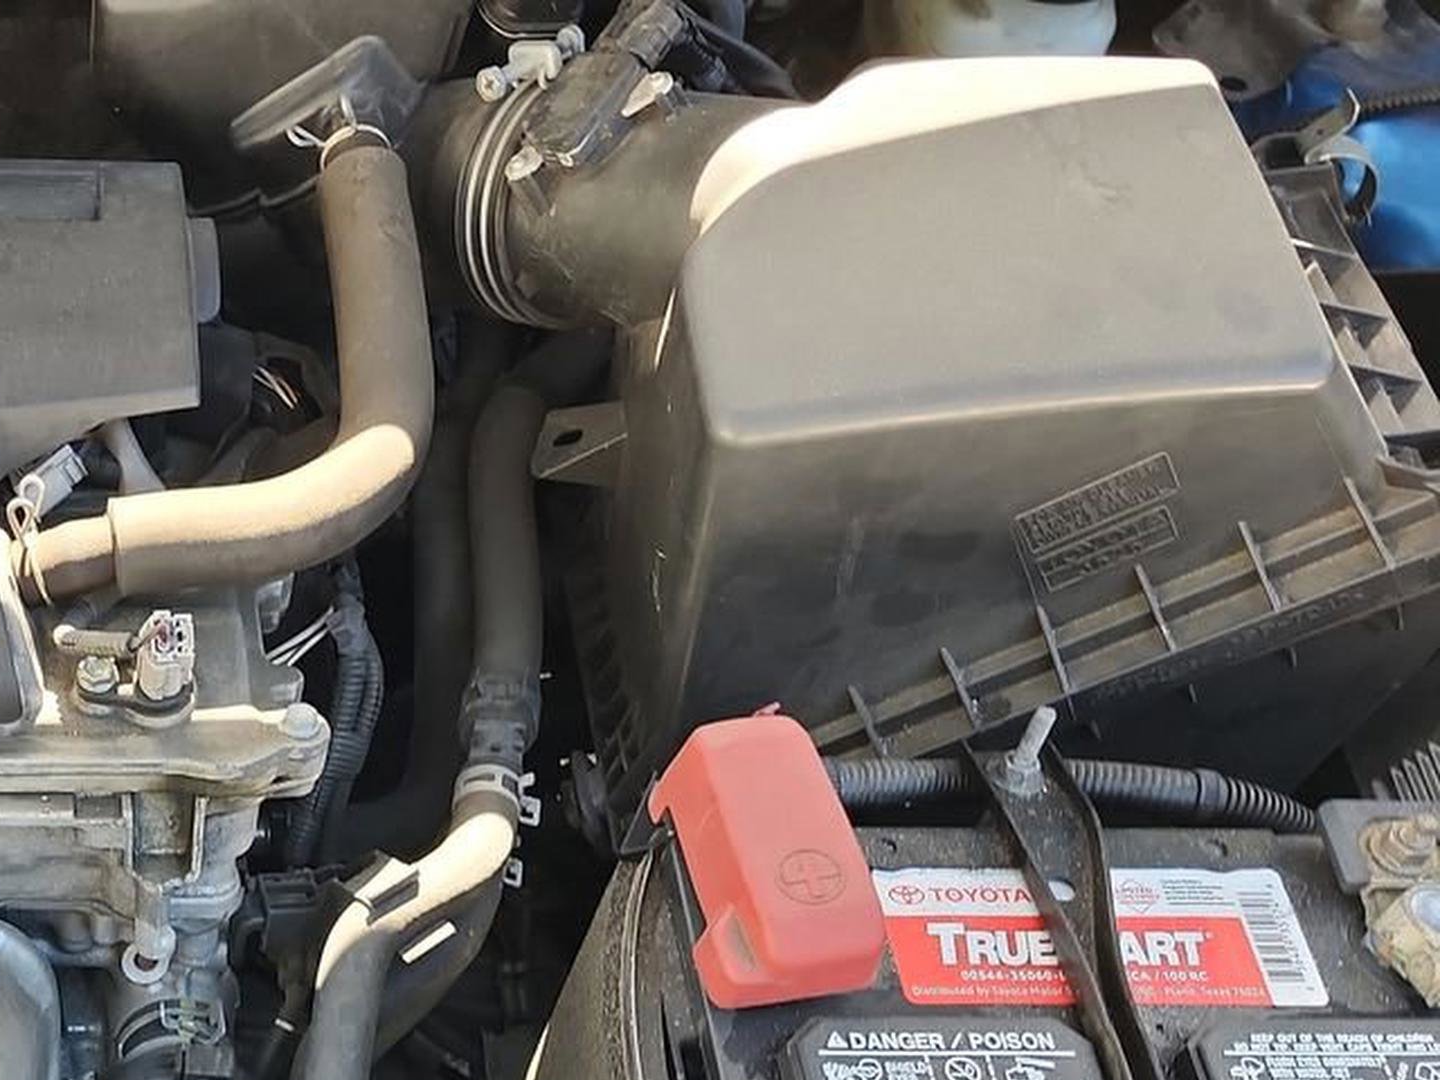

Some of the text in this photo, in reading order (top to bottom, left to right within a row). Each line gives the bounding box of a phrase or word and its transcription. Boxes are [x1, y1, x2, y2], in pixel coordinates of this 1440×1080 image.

[929, 888, 1032, 902] TOYOTA
[848, 1032, 1056, 1050] DANGER / POISON
